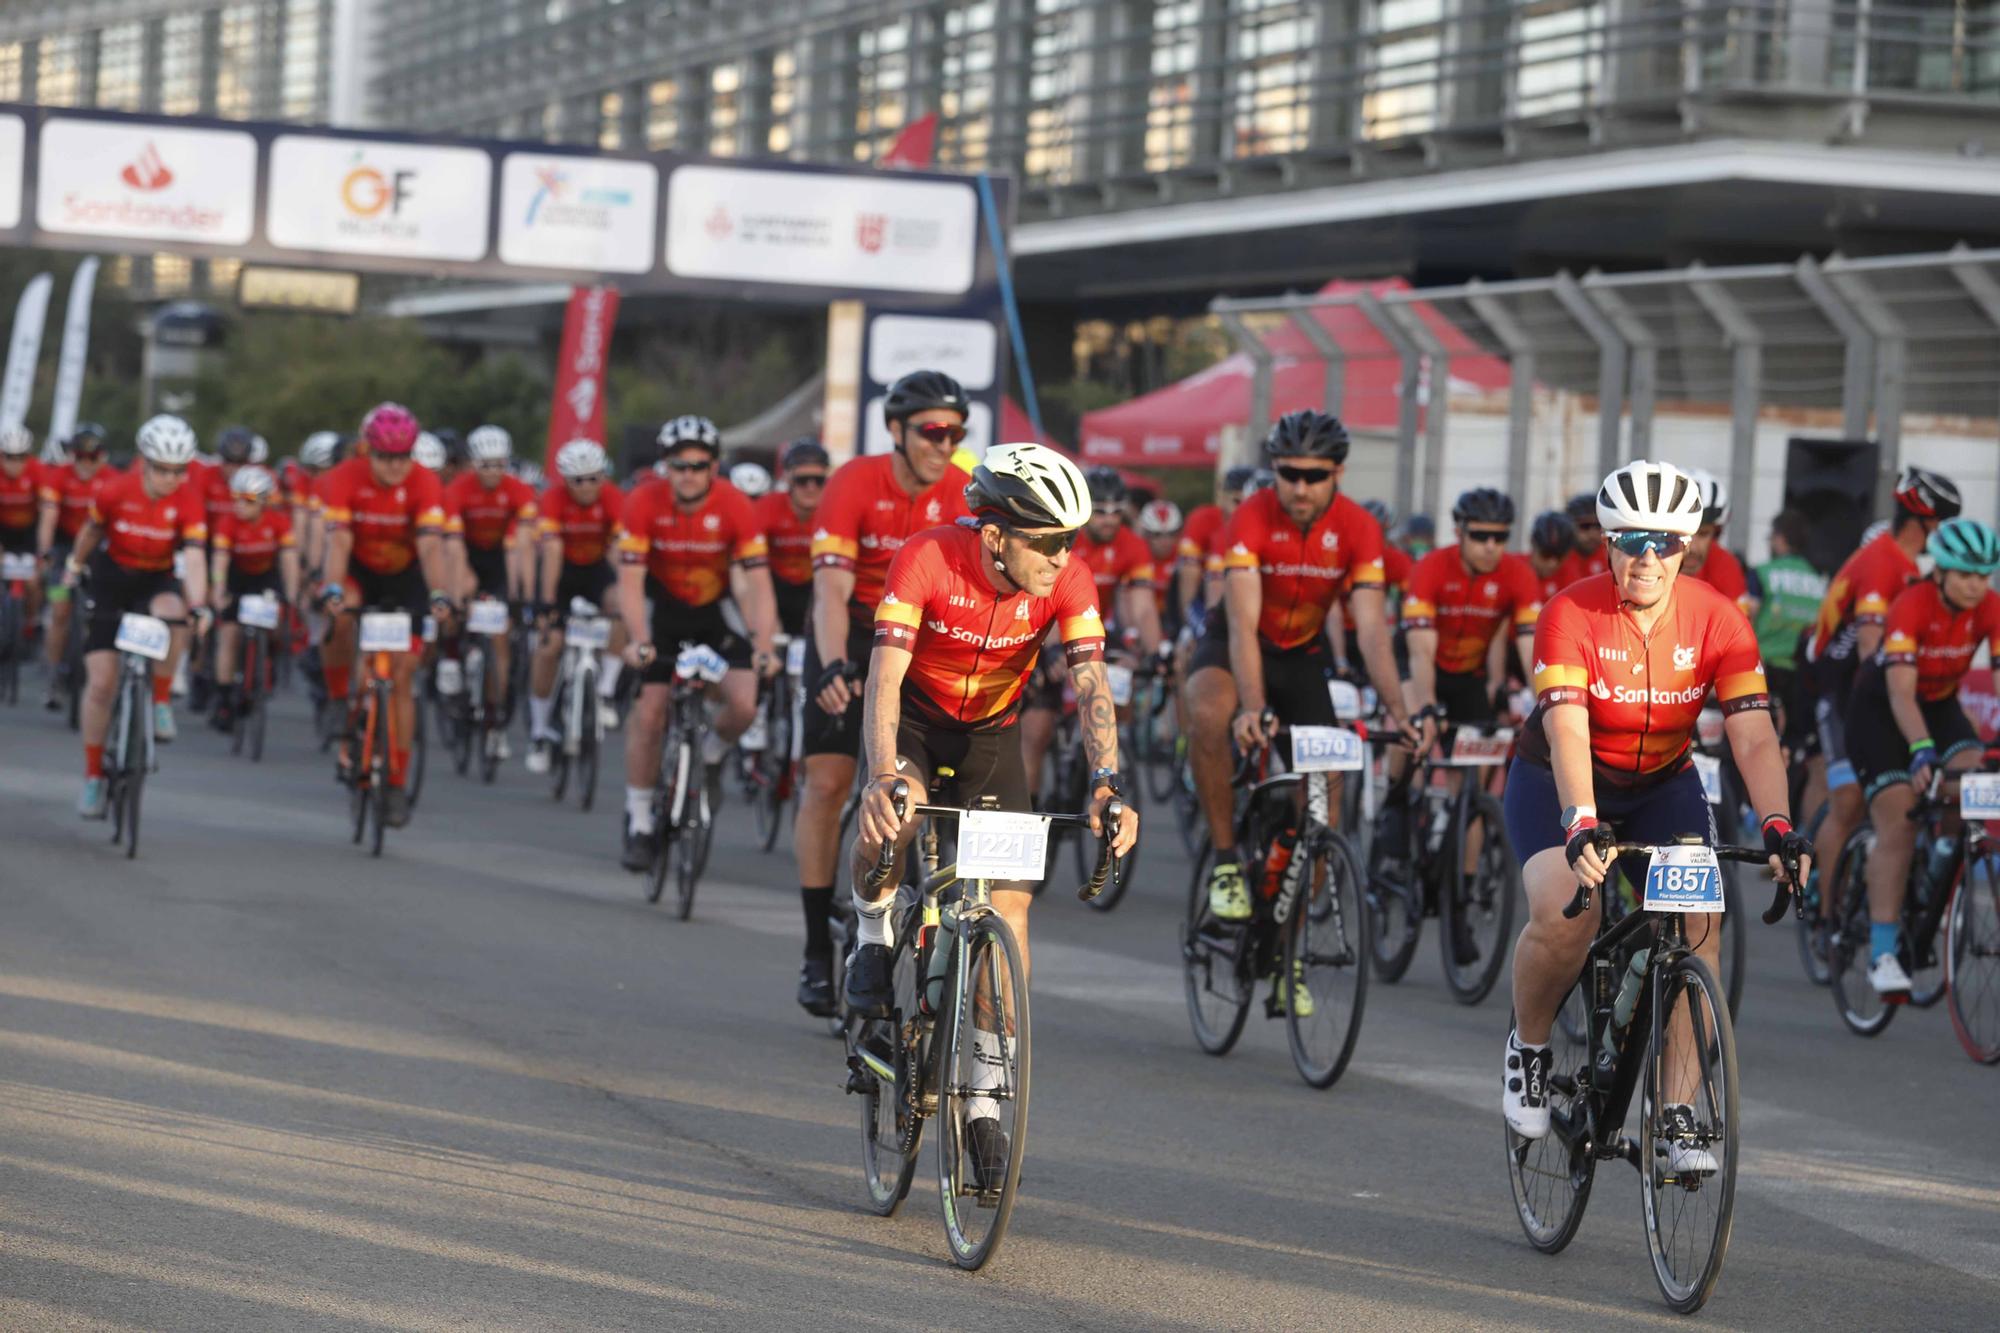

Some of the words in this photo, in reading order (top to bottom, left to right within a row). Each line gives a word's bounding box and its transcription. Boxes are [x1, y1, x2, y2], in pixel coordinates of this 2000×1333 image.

[1008, 451, 1034, 482] MET
[1613, 683, 1706, 704] Santander
[1301, 739, 1347, 756] 1570
[967, 833, 1024, 858] 1221
[1654, 866, 1710, 892] 1857
